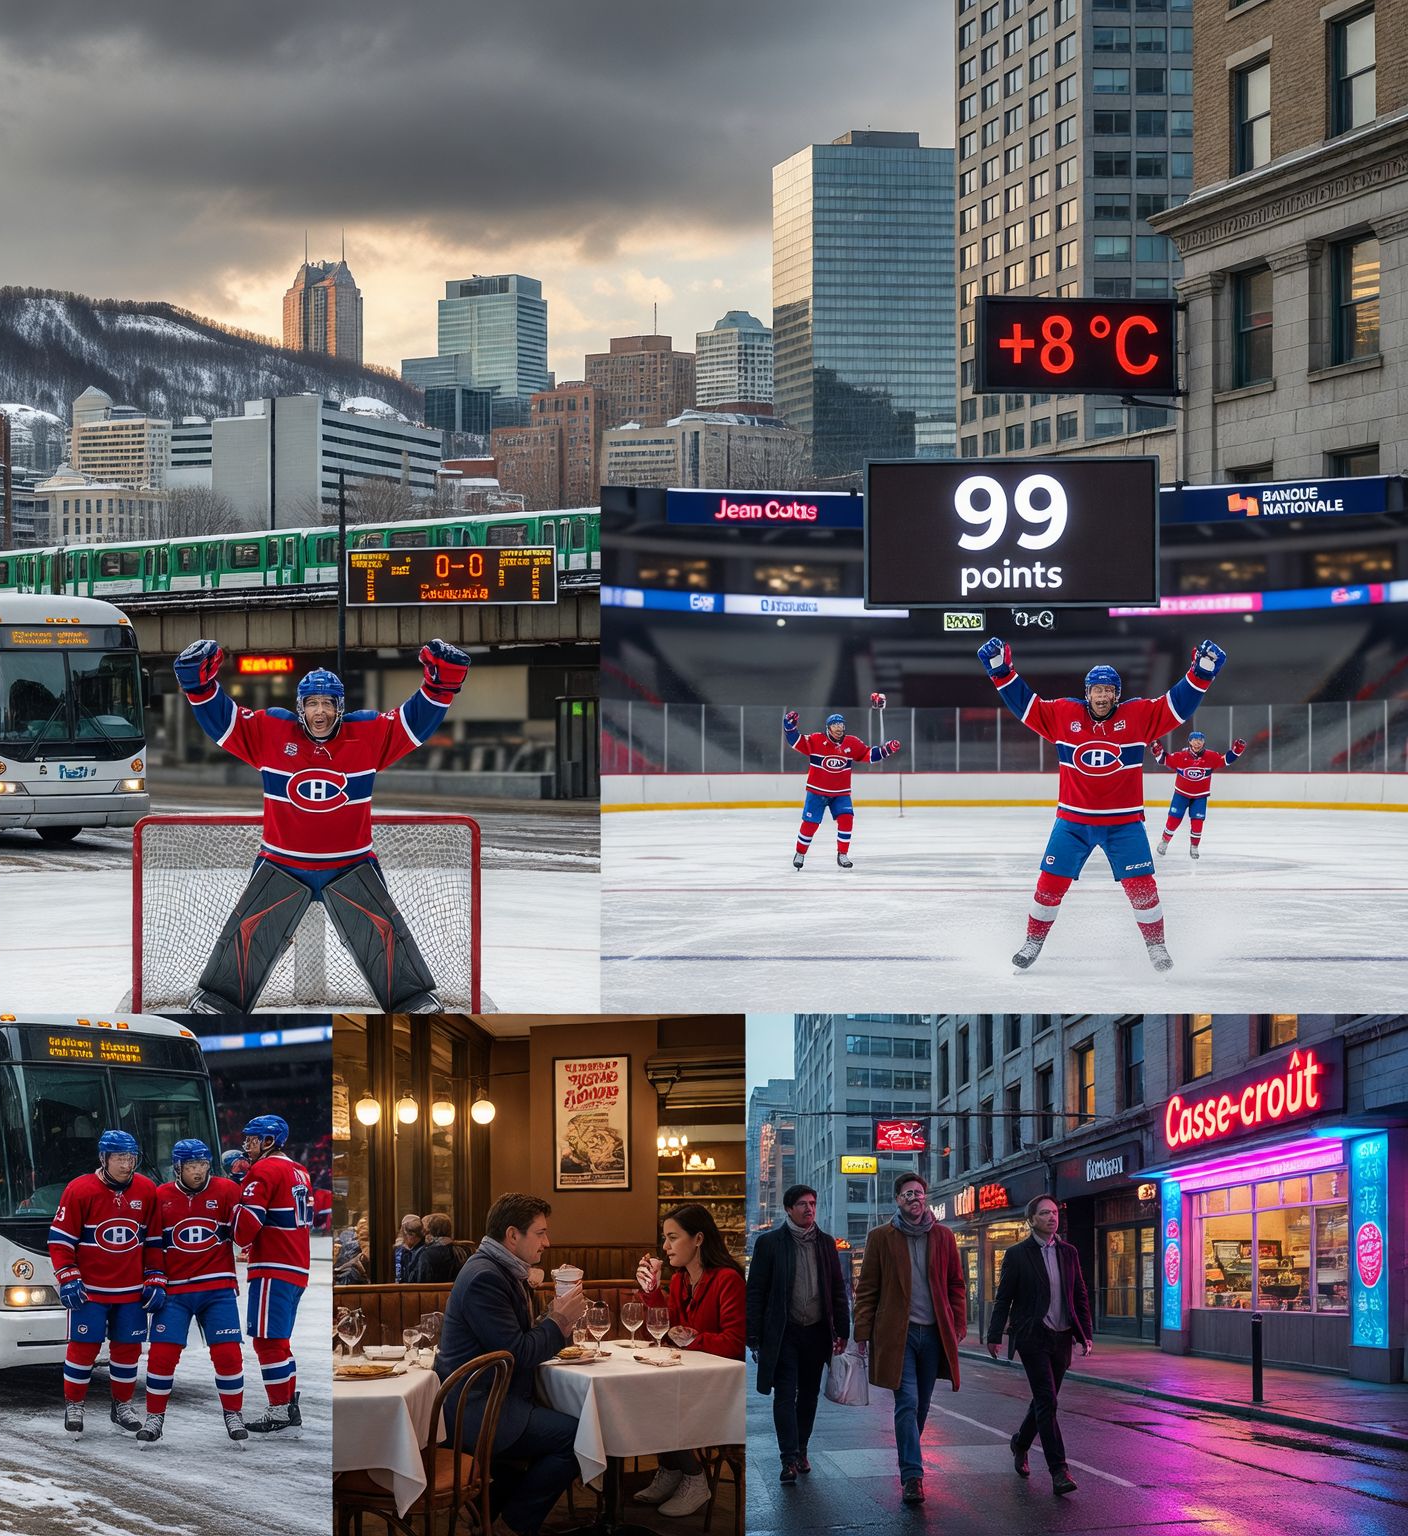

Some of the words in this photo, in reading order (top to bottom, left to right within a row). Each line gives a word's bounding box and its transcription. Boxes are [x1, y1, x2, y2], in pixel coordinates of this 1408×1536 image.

[715, 498, 762, 519] Jean
[954, 474, 1068, 550] 99
[1263, 499, 1344, 515] NATIONALE
[961, 559, 1063, 596] points
[1166, 1051, 1318, 1147] Casse-croût
